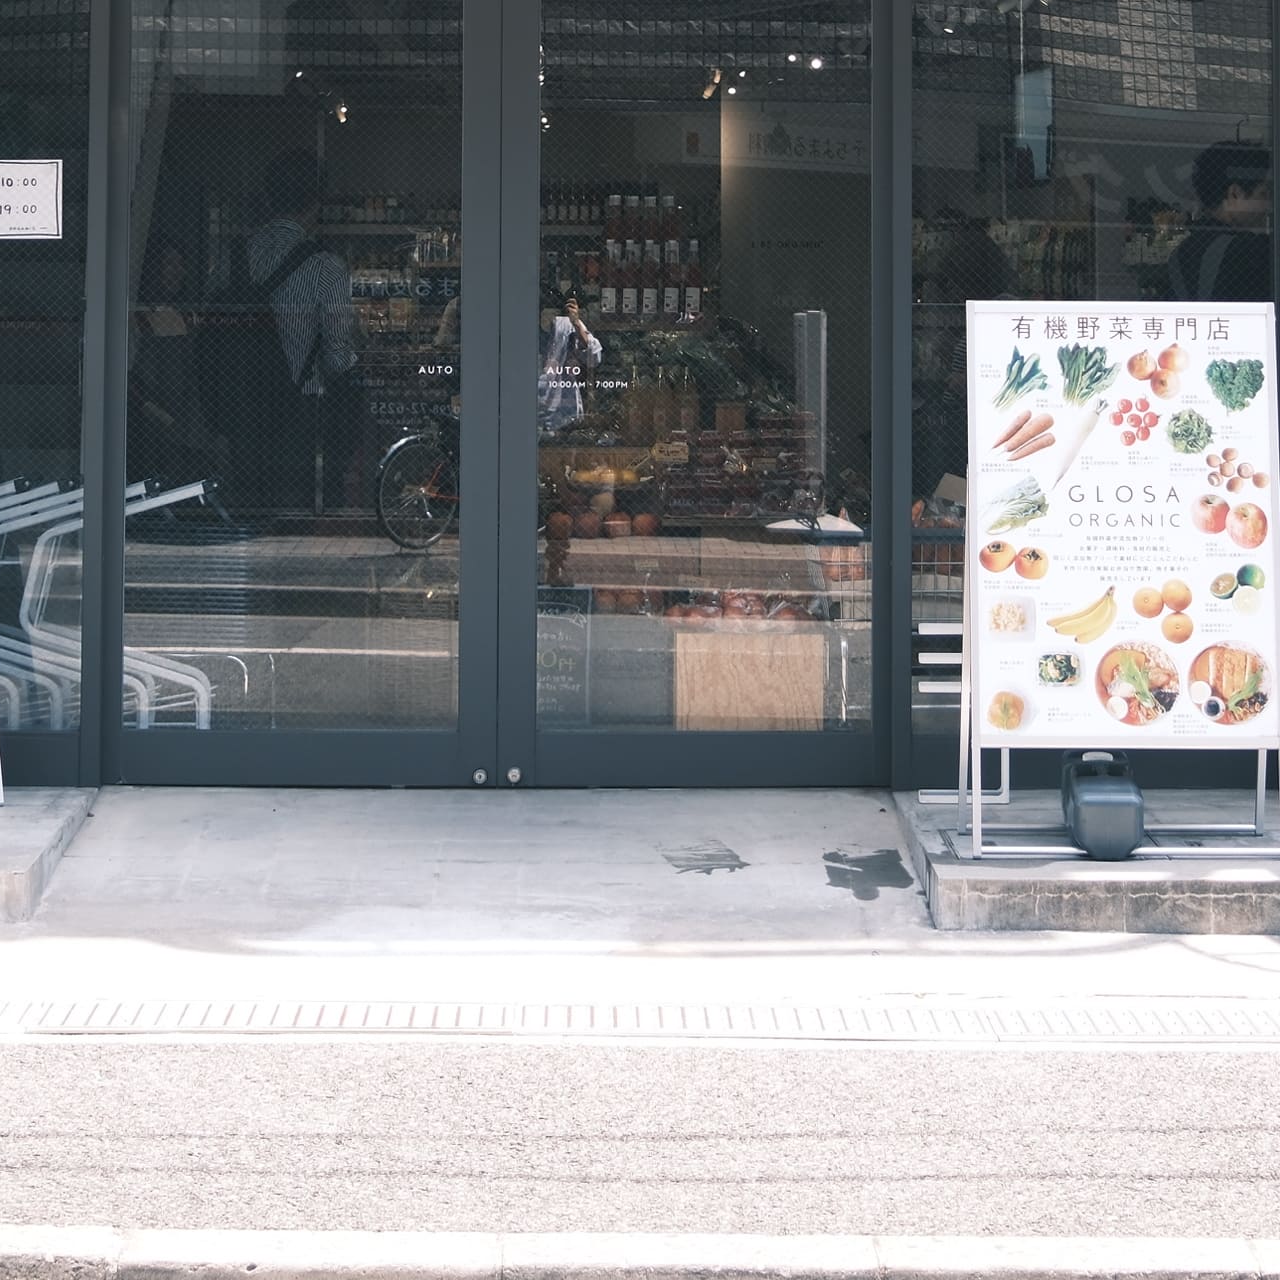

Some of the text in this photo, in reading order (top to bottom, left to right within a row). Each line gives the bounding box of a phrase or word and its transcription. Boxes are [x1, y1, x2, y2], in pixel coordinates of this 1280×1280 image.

[1, 177, 38, 187] 10:00
[0, 204, 38, 215] 19:00
[1010, 315, 1232, 342] 有機野菜専門店
[418, 365, 454, 375] AUTO
[546, 366, 581, 375] AUTO
[1068, 484, 1181, 504] GLOSA
[1068, 512, 1181, 528] ORGANIC
